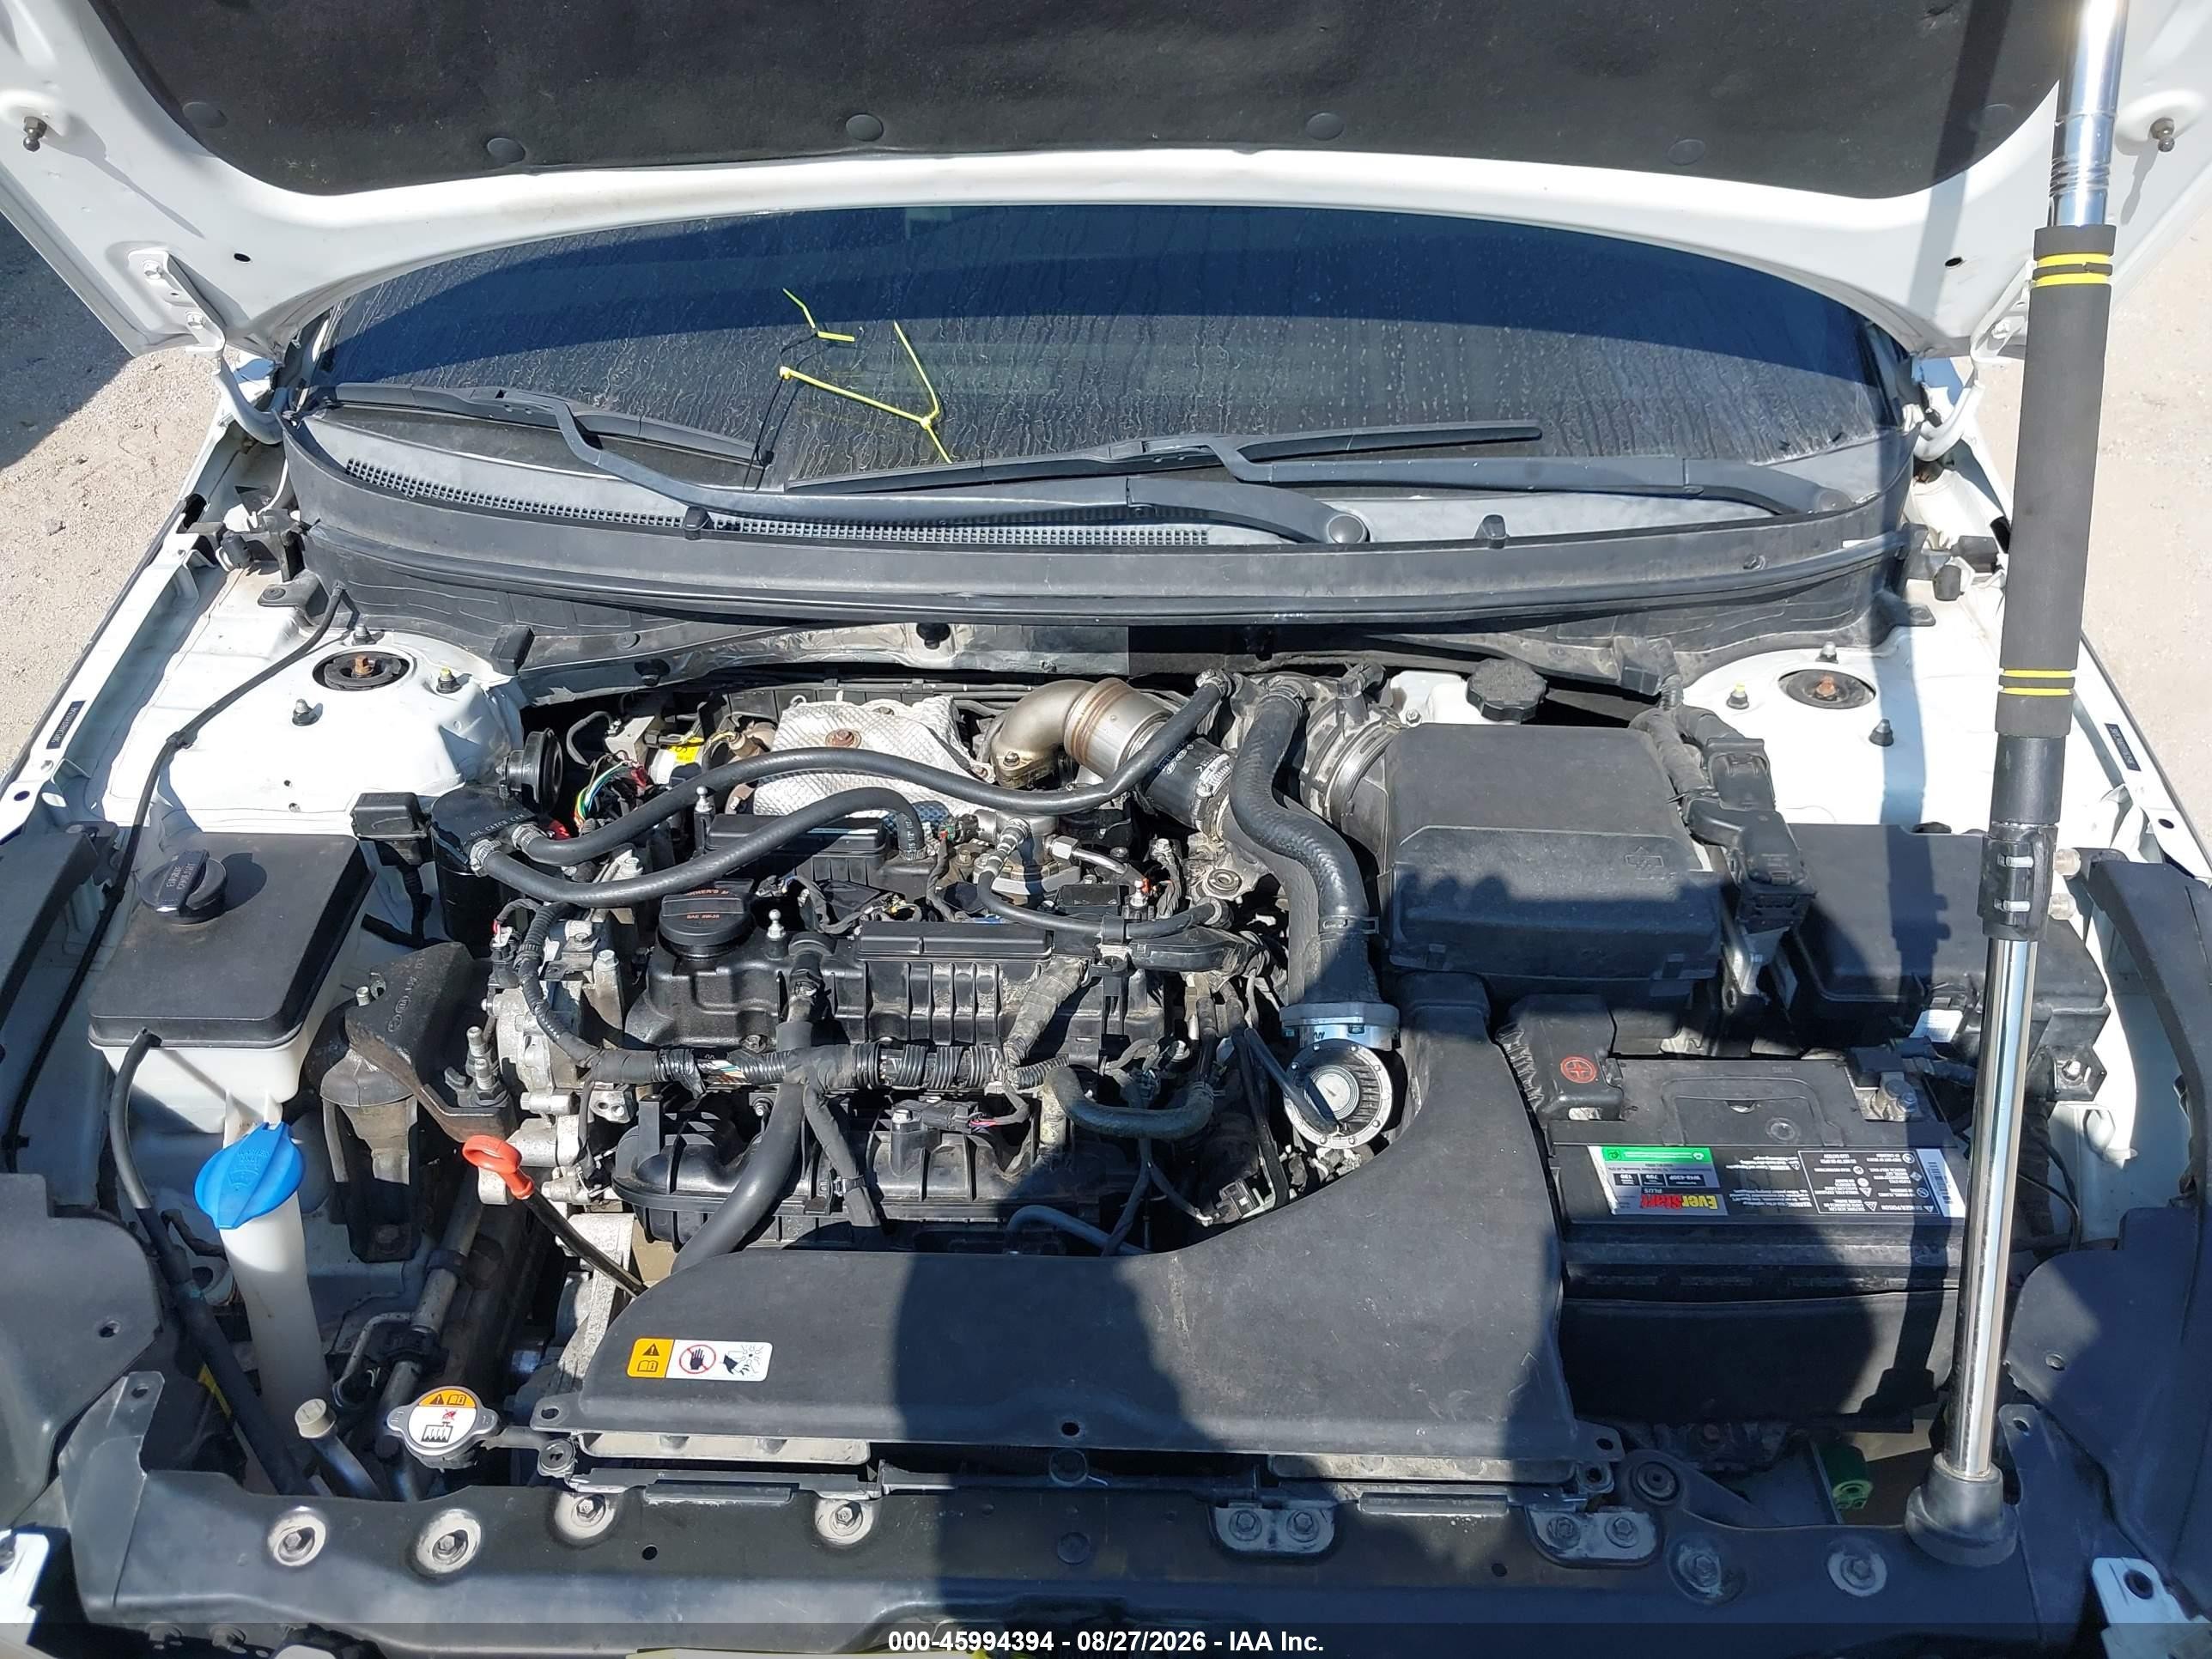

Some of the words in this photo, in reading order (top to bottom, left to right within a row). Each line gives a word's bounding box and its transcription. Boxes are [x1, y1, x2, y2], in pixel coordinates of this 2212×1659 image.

[470, 830, 483, 838] OIL
[485, 820, 508, 831] CATCH
[510, 813, 525, 822] CAN
[1640, 1194, 1719, 1210] EverStart
